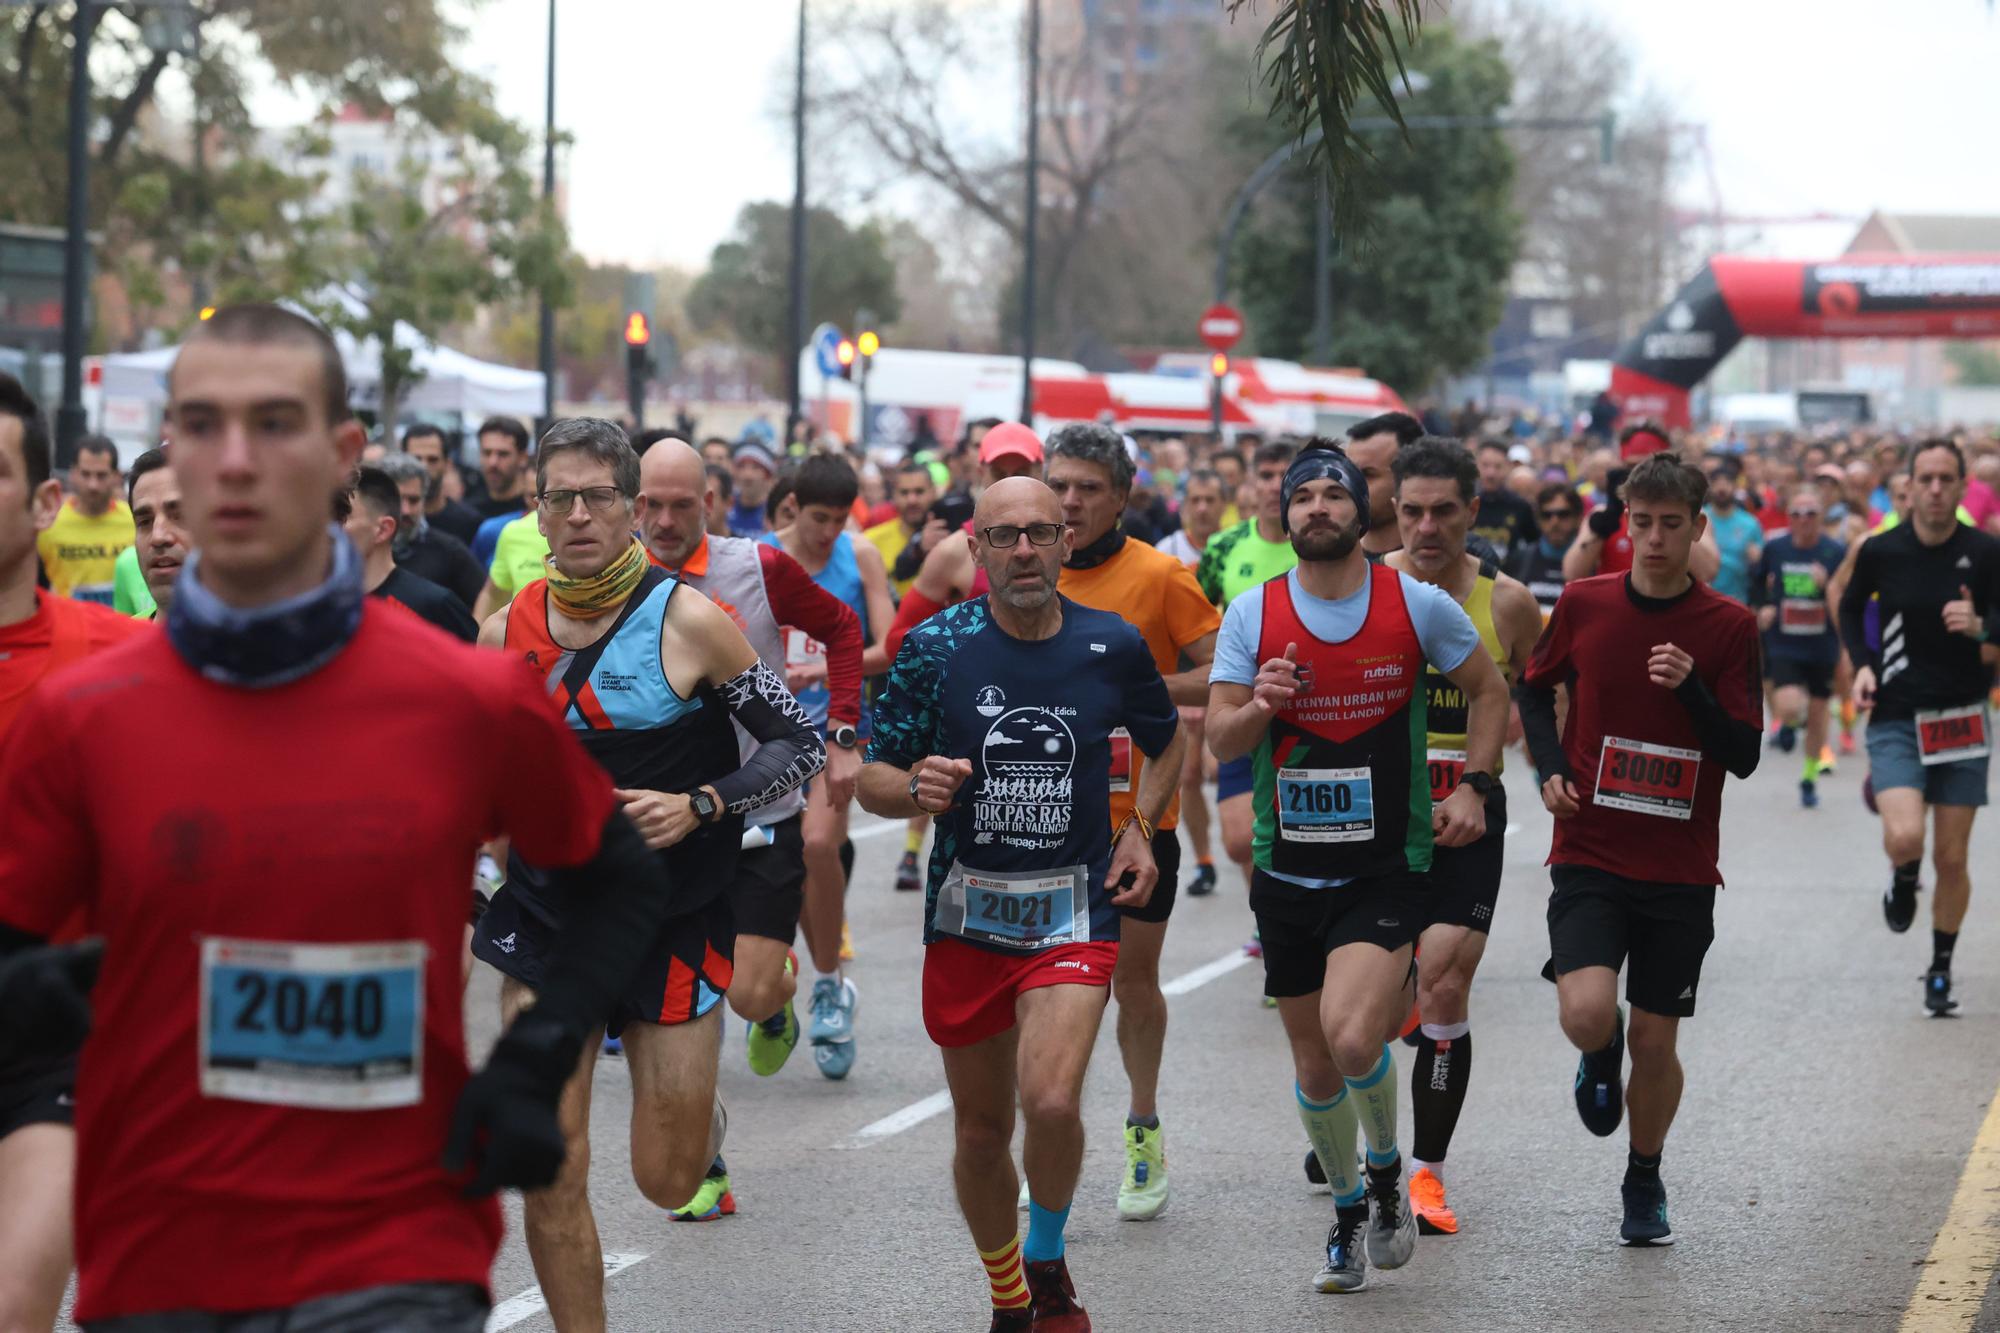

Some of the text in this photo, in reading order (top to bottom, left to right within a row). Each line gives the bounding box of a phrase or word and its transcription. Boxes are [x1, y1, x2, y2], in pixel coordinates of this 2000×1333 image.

[1296, 695, 1340, 708] KENYAN
[1343, 692, 1384, 706] URBAN
[1386, 687, 1408, 699] WAY
[1297, 711, 1341, 722] RAQUEL
[1611, 751, 1683, 788] 3009
[1287, 783, 1352, 813] 2160
[973, 802, 1072, 824] 10K PAS RAS
[973, 819, 983, 831] AL
[984, 820, 1011, 831] PORT
[1011, 822, 1025, 833] DE
[1000, 835, 1066, 850] Hapag-Lloyd
[981, 892, 1053, 928] 2021
[233, 971, 385, 1041] 2040
